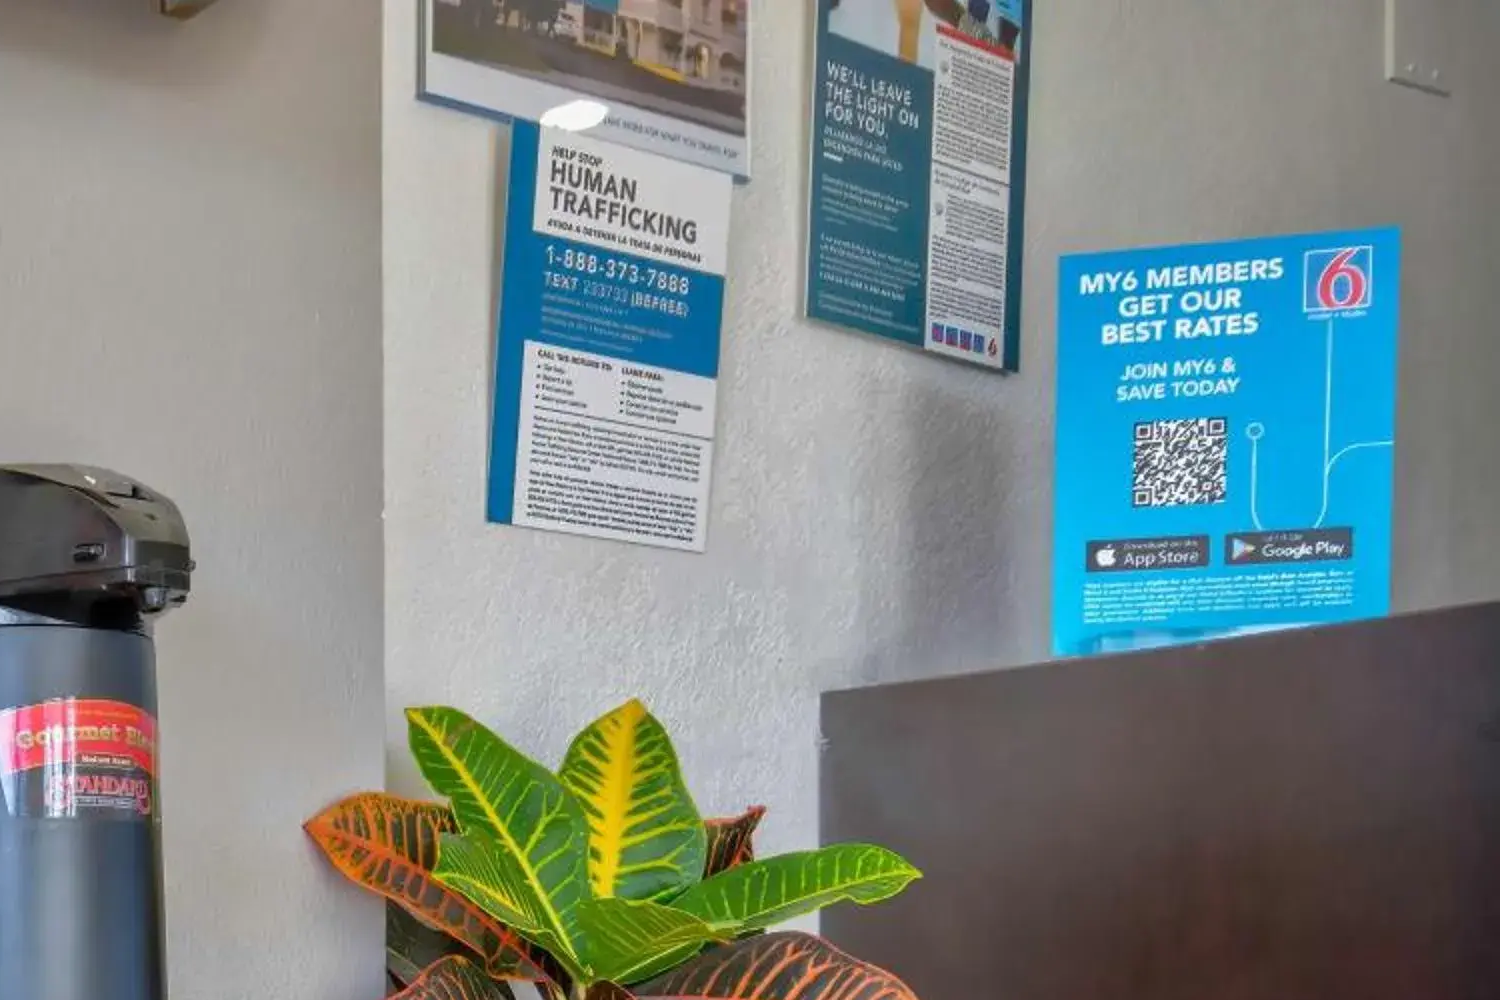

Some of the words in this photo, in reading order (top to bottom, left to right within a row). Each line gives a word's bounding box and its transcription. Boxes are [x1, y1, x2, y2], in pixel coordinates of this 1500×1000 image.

[827, 60, 867, 90] WE'LL
[871, 77, 912, 107] LEAVE
[825, 81, 853, 104] THE
[856, 92, 895, 120] LIGHT
[899, 107, 919, 129] ON
[825, 101, 853, 125] FOR
[551, 146, 577, 161] HELP
[578, 151, 603, 166] STOP
[550, 159, 637, 203] HUMAN
[550, 187, 697, 245] TRAFFICKING
[544, 271, 579, 292] TEXT
[546, 244, 690, 295] 1-888-373-7888
[1079, 270, 1138, 295] MY6
[1147, 257, 1284, 289] MEMBERS
[1118, 294, 1172, 318] GET
[1181, 288, 1241, 312] OUR
[1101, 320, 1167, 346] BEST
[1174, 312, 1259, 339] RATES
[1120, 360, 1167, 382] JOIN
[1173, 357, 1216, 377] MY6
[1221, 356, 1236, 374] &
[1116, 380, 1166, 402] SAVE
[1171, 377, 1241, 398] TODAY
[1124, 551, 1157, 567] App
[1158, 549, 1199, 565] Store
[1261, 541, 1314, 559] Google
[1315, 539, 1346, 556] Play
[15, 722, 121, 750] Gourmet
